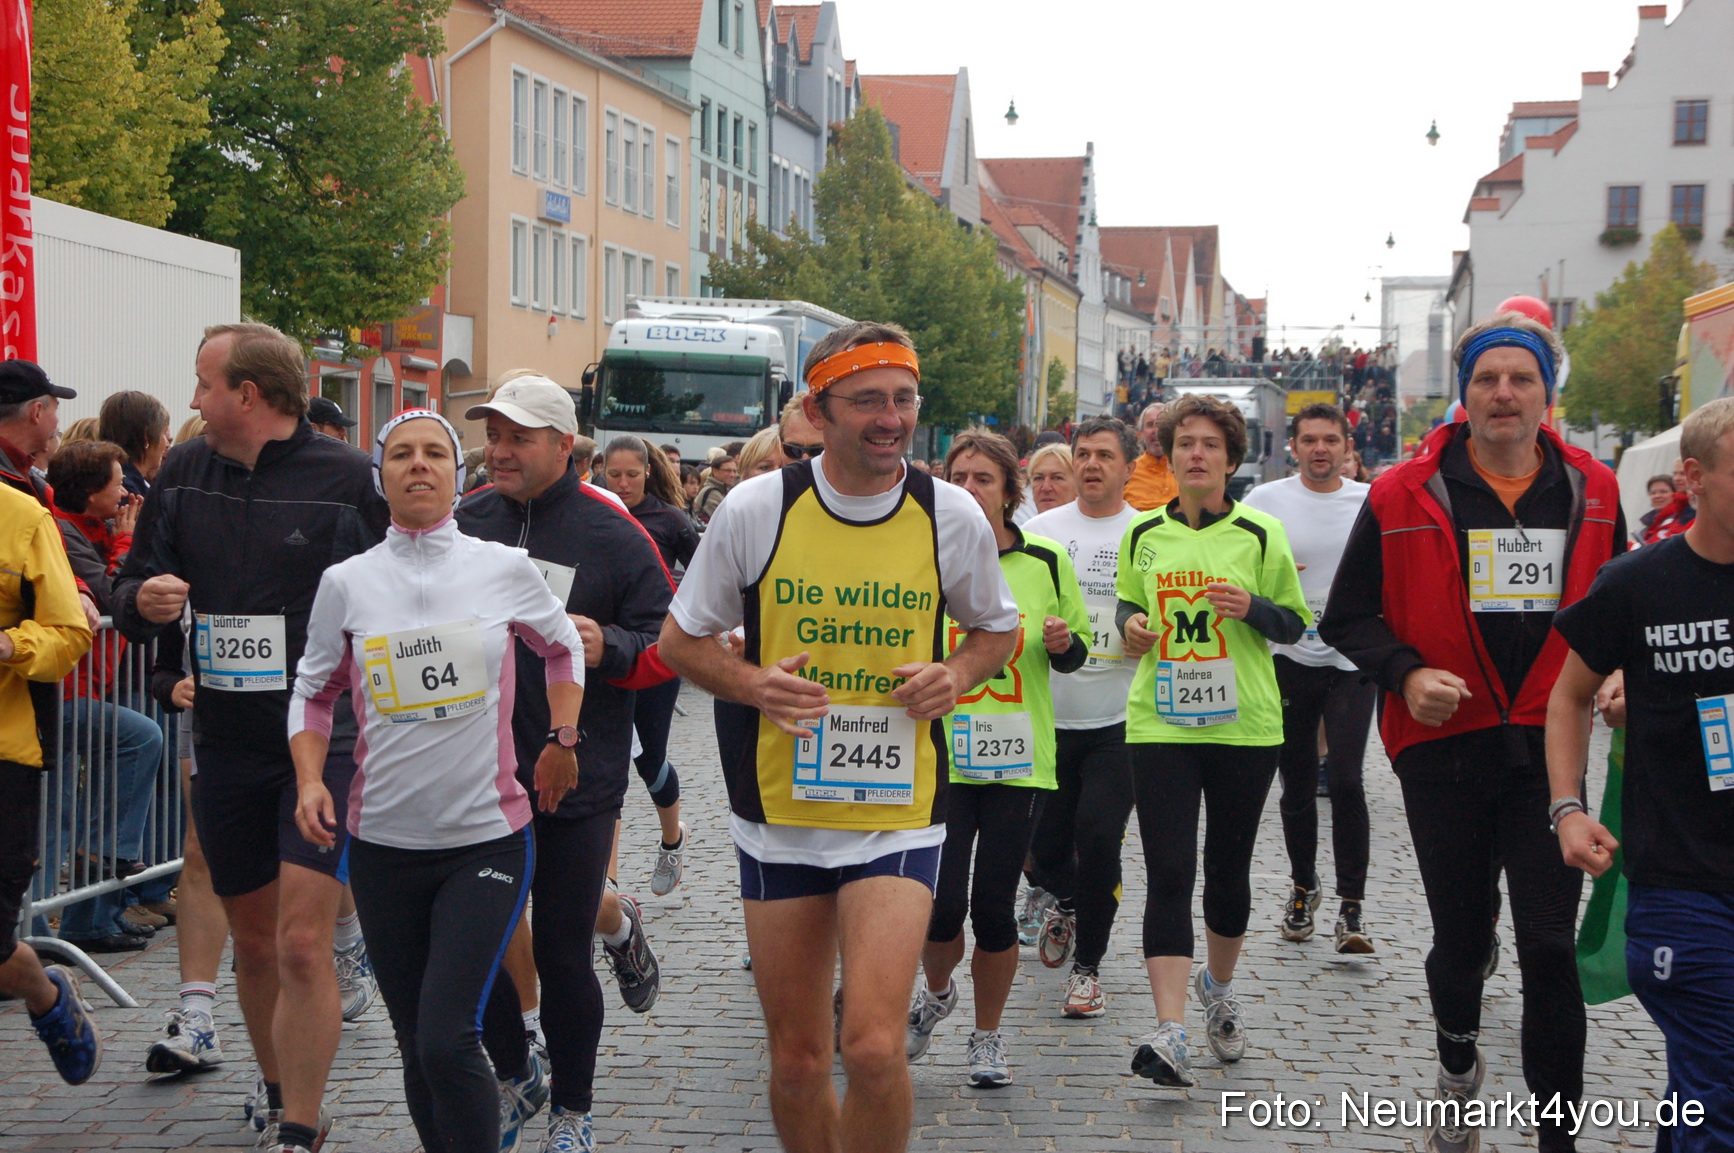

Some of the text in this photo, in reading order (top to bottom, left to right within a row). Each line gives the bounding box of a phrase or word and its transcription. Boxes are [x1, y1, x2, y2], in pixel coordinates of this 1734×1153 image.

[647, 326, 727, 342] BOCK
[1498, 538, 1542, 552] Hubert
[1474, 562, 1480, 573] D
[1507, 563, 1553, 585] 291
[775, 579, 932, 611] Die wilden
[213, 614, 250, 628] Günter
[1174, 611, 1211, 643] M
[797, 617, 914, 648] Gärtner
[1645, 619, 1731, 647] HEUTE
[216, 638, 272, 659] 3266
[396, 636, 442, 659] Judith
[1654, 646, 1734, 673] AUTOG
[244, 675, 284, 684] PFLEIDERER
[373, 673, 381, 686] D
[421, 662, 459, 691] 64
[1177, 669, 1212, 681] Andrea
[1160, 685, 1165, 694] D
[1179, 685, 1226, 704] 2411
[447, 695, 486, 712] PFLEIDERER
[830, 714, 888, 733] Manfred
[976, 720, 992, 732] Iris
[802, 740, 809, 752] D
[1712, 732, 1720, 744] D
[830, 743, 901, 769] 2445
[977, 738, 1025, 757] 2373
[867, 789, 912, 798] PFLEIDERER
[491, 871, 514, 884] asics
[1653, 946, 1673, 980] 9
